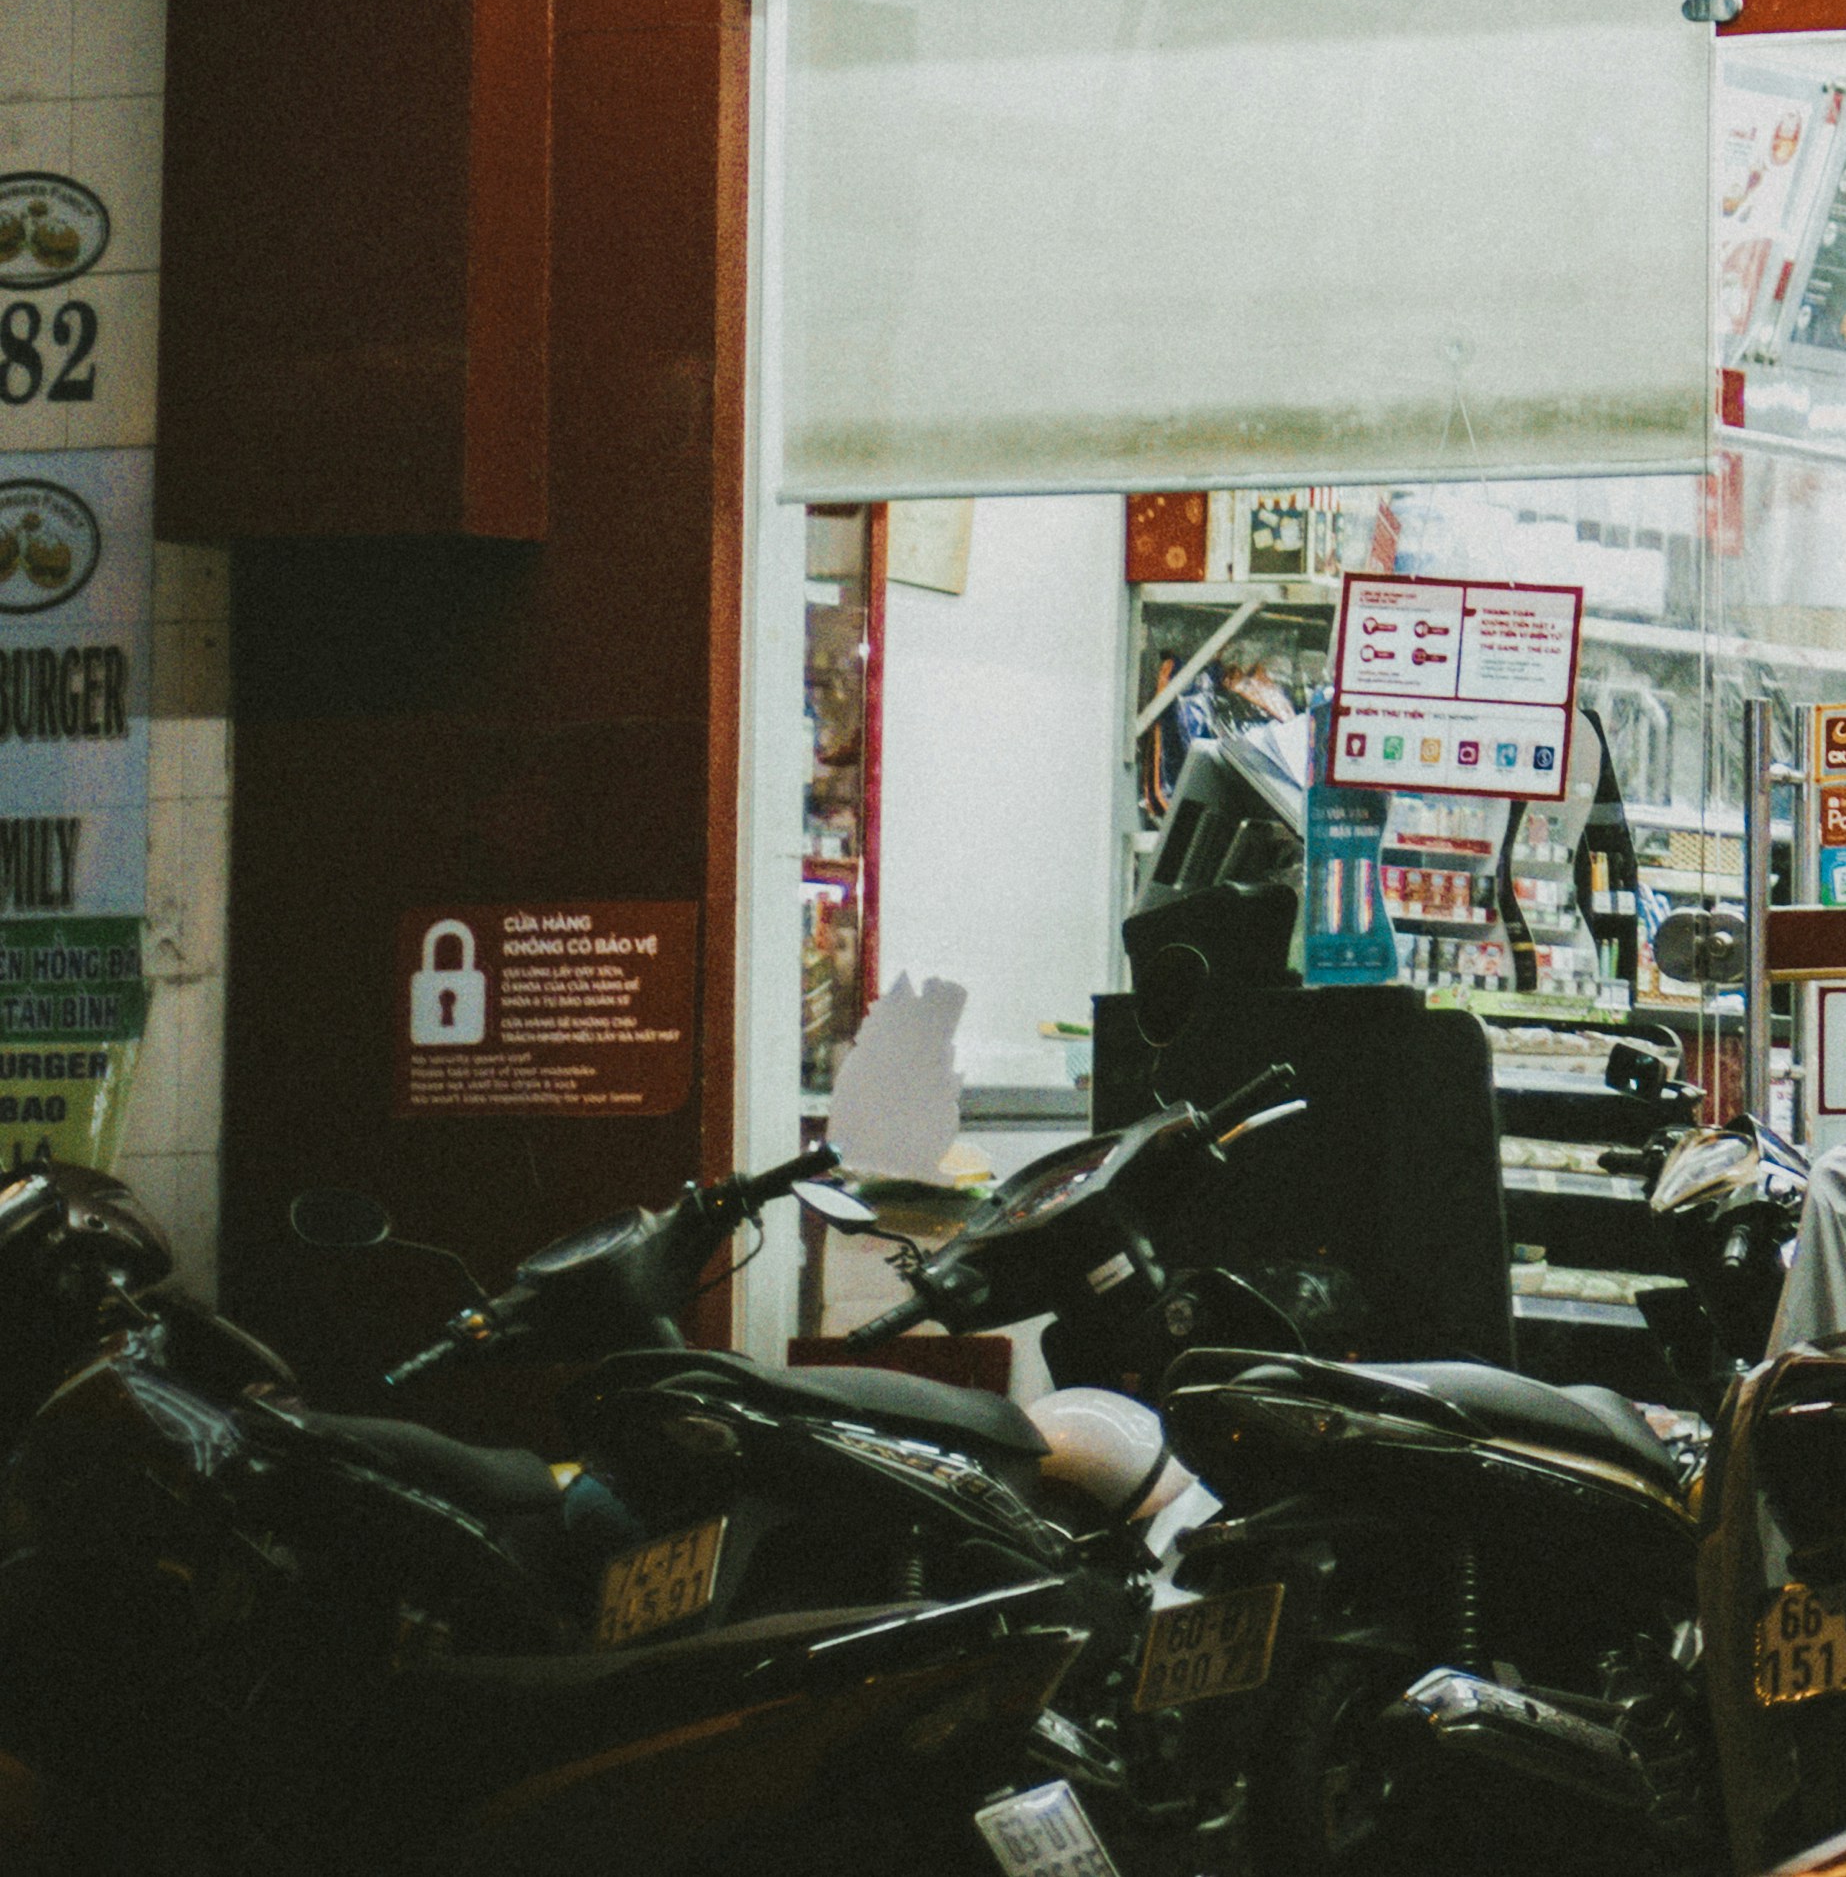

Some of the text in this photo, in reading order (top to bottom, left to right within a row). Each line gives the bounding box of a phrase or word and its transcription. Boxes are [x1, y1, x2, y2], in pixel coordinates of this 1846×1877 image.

[542, 911, 592, 932] HÀNG
[503, 931, 658, 959] KHÔNG CÓ BẢO VỆ
